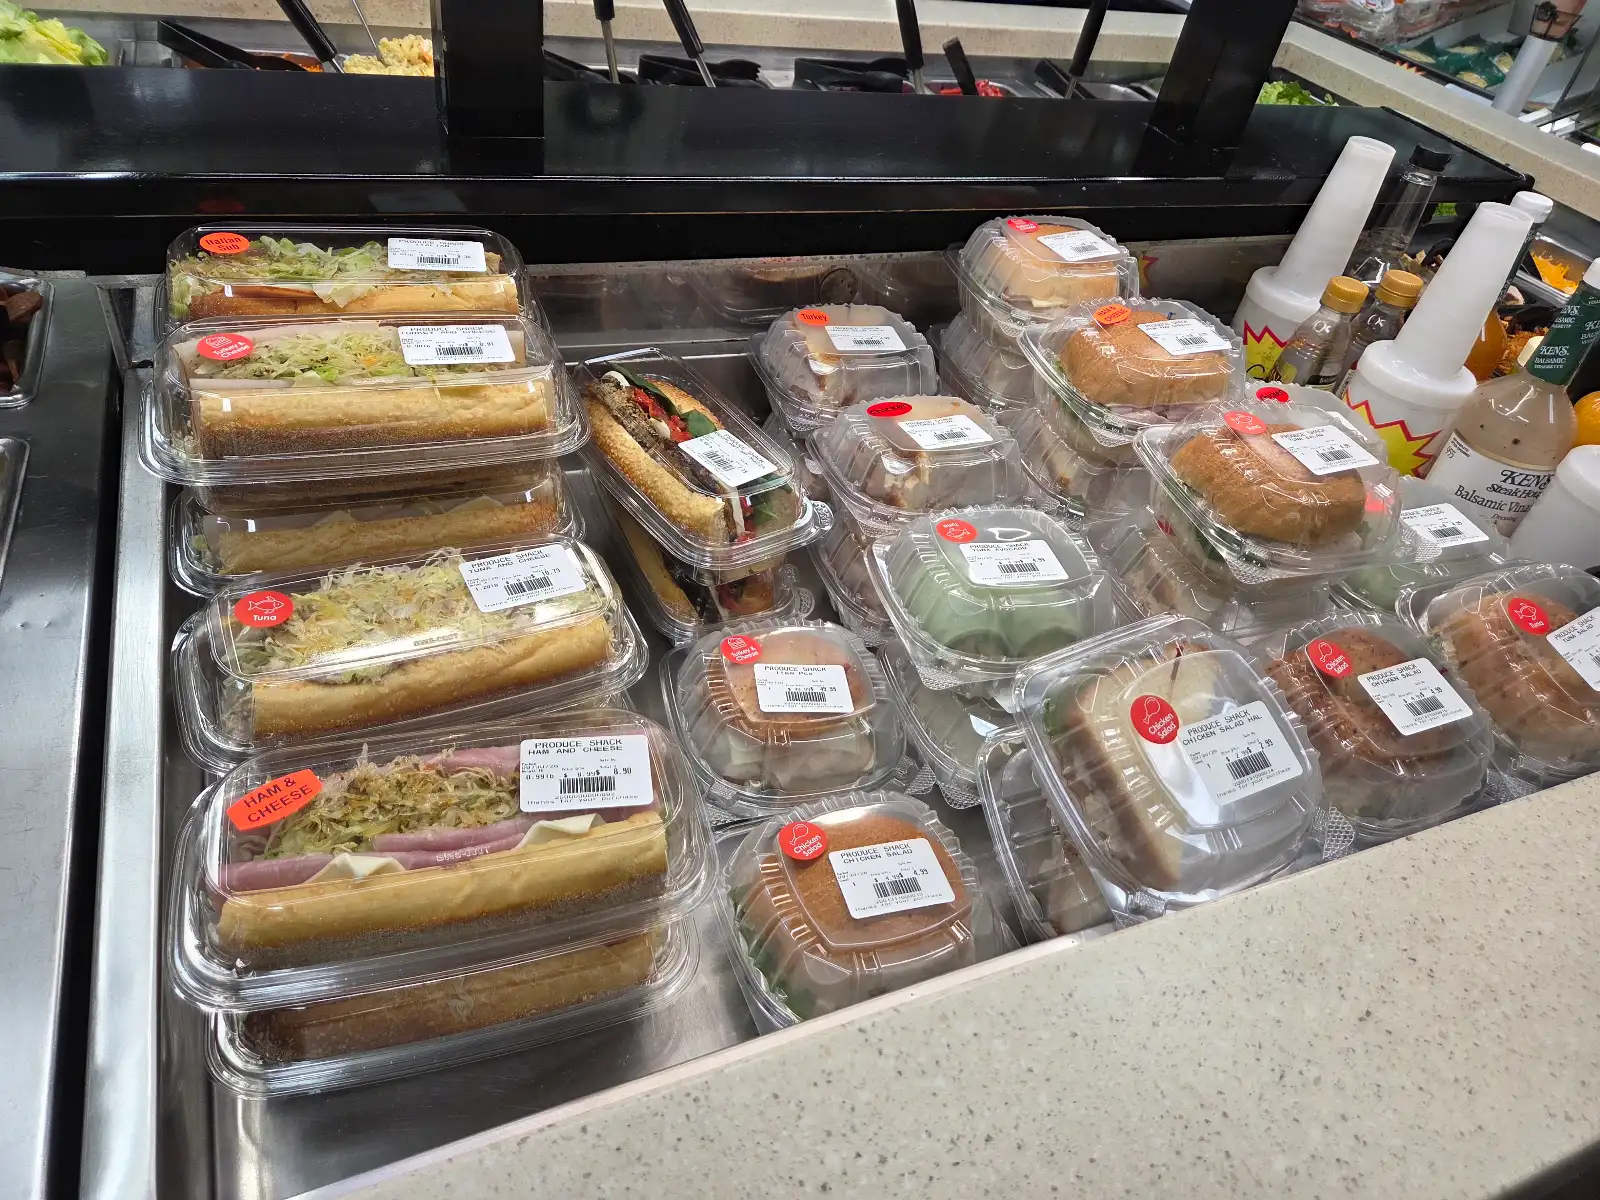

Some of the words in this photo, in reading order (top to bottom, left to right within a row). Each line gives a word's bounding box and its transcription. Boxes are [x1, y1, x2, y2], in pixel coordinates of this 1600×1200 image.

[204, 236, 242, 244] Italian
[217, 243, 240, 251] Sub
[801, 313, 827, 321] Turkey
[212, 343, 239, 355] Turkey
[220, 345, 251, 358] Cheese
[1454, 485, 1508, 511] Balsamic
[1486, 483, 1520, 498] Steak
[470, 556, 512, 568] PRODUCE
[515, 549, 544, 559] SHACK
[518, 553, 552, 563] CHEESE
[1528, 620, 1545, 628] Tuna
[1553, 624, 1578, 640] PRODUCE
[1578, 614, 1597, 627] SHACK
[1562, 633, 1577, 643] TUNA
[1577, 623, 1594, 634] SALAD
[731, 648, 751, 657] Turkey
[736, 651, 760, 661] Cheese
[1325, 655, 1345, 670] Chicken
[1333, 662, 1350, 674] Salad
[1366, 670, 1394, 681] PRODUCE
[1396, 663, 1418, 673] SHACK
[1371, 675, 1400, 687] CHICKEN
[1402, 669, 1422, 677] SALAD
[1148, 712, 1174, 734] Chicken
[1187, 720, 1222, 736] PRODUCE
[1225, 708, 1252, 723] SHACK
[1157, 722, 1177, 738] Salad
[1182, 730, 1217, 746] CHICKEN
[1219, 720, 1245, 733] SALAD
[535, 740, 583, 748] PRODUCE
[589, 738, 623, 746] SHACK
[1259, 739, 1274, 750] 2.99
[613, 767, 632, 775] 8.90
[243, 783, 283, 807] HAM
[283, 777, 297, 787] &
[247, 784, 313, 822] CHEESE
[793, 835, 822, 853] Chicken
[802, 842, 823, 856] Salad
[840, 847, 882, 858] PRODUCE
[883, 843, 912, 853] SHACK
[843, 853, 882, 864] CHICKEN
[886, 849, 914, 858] SALAD
[913, 868, 929, 876] 4.99
